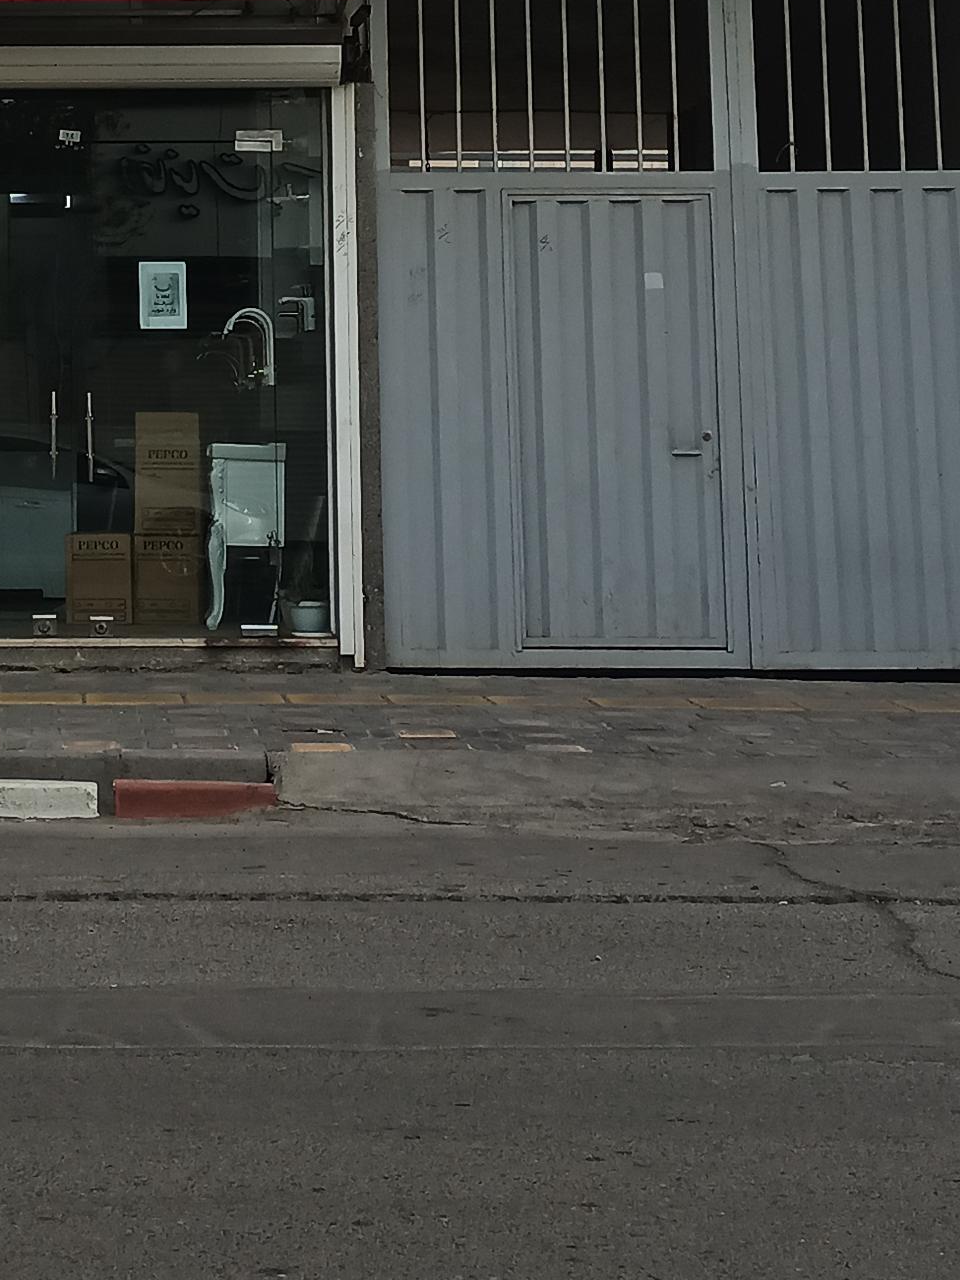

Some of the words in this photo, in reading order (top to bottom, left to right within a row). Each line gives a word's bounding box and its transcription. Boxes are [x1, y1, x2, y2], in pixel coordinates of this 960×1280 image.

[147, 449, 188, 460] PEPCO
[78, 539, 120, 551] PEPCO
[143, 539, 184, 551] PEPCO
